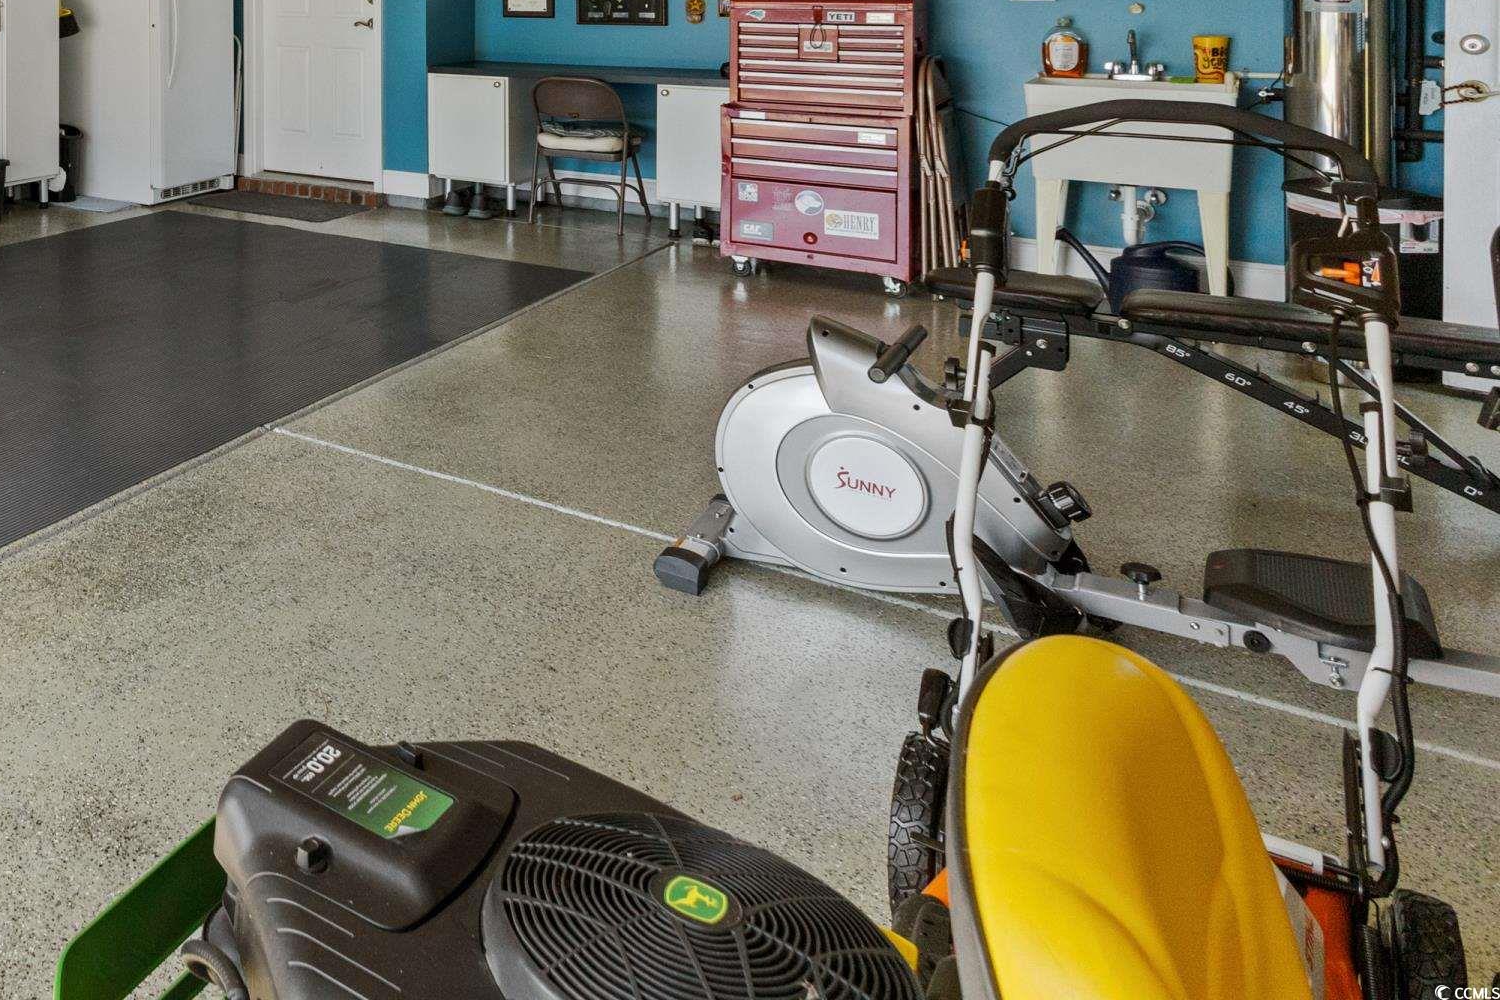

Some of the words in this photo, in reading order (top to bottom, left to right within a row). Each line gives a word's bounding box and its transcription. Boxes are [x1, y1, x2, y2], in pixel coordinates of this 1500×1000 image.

[828, 12, 854, 21] YETI
[843, 213, 876, 233] HENRY
[833, 466, 897, 498] SUNNY
[306, 744, 342, 774] 20.0
[408, 790, 428, 814] JOHN
[384, 808, 412, 833] DEERE
